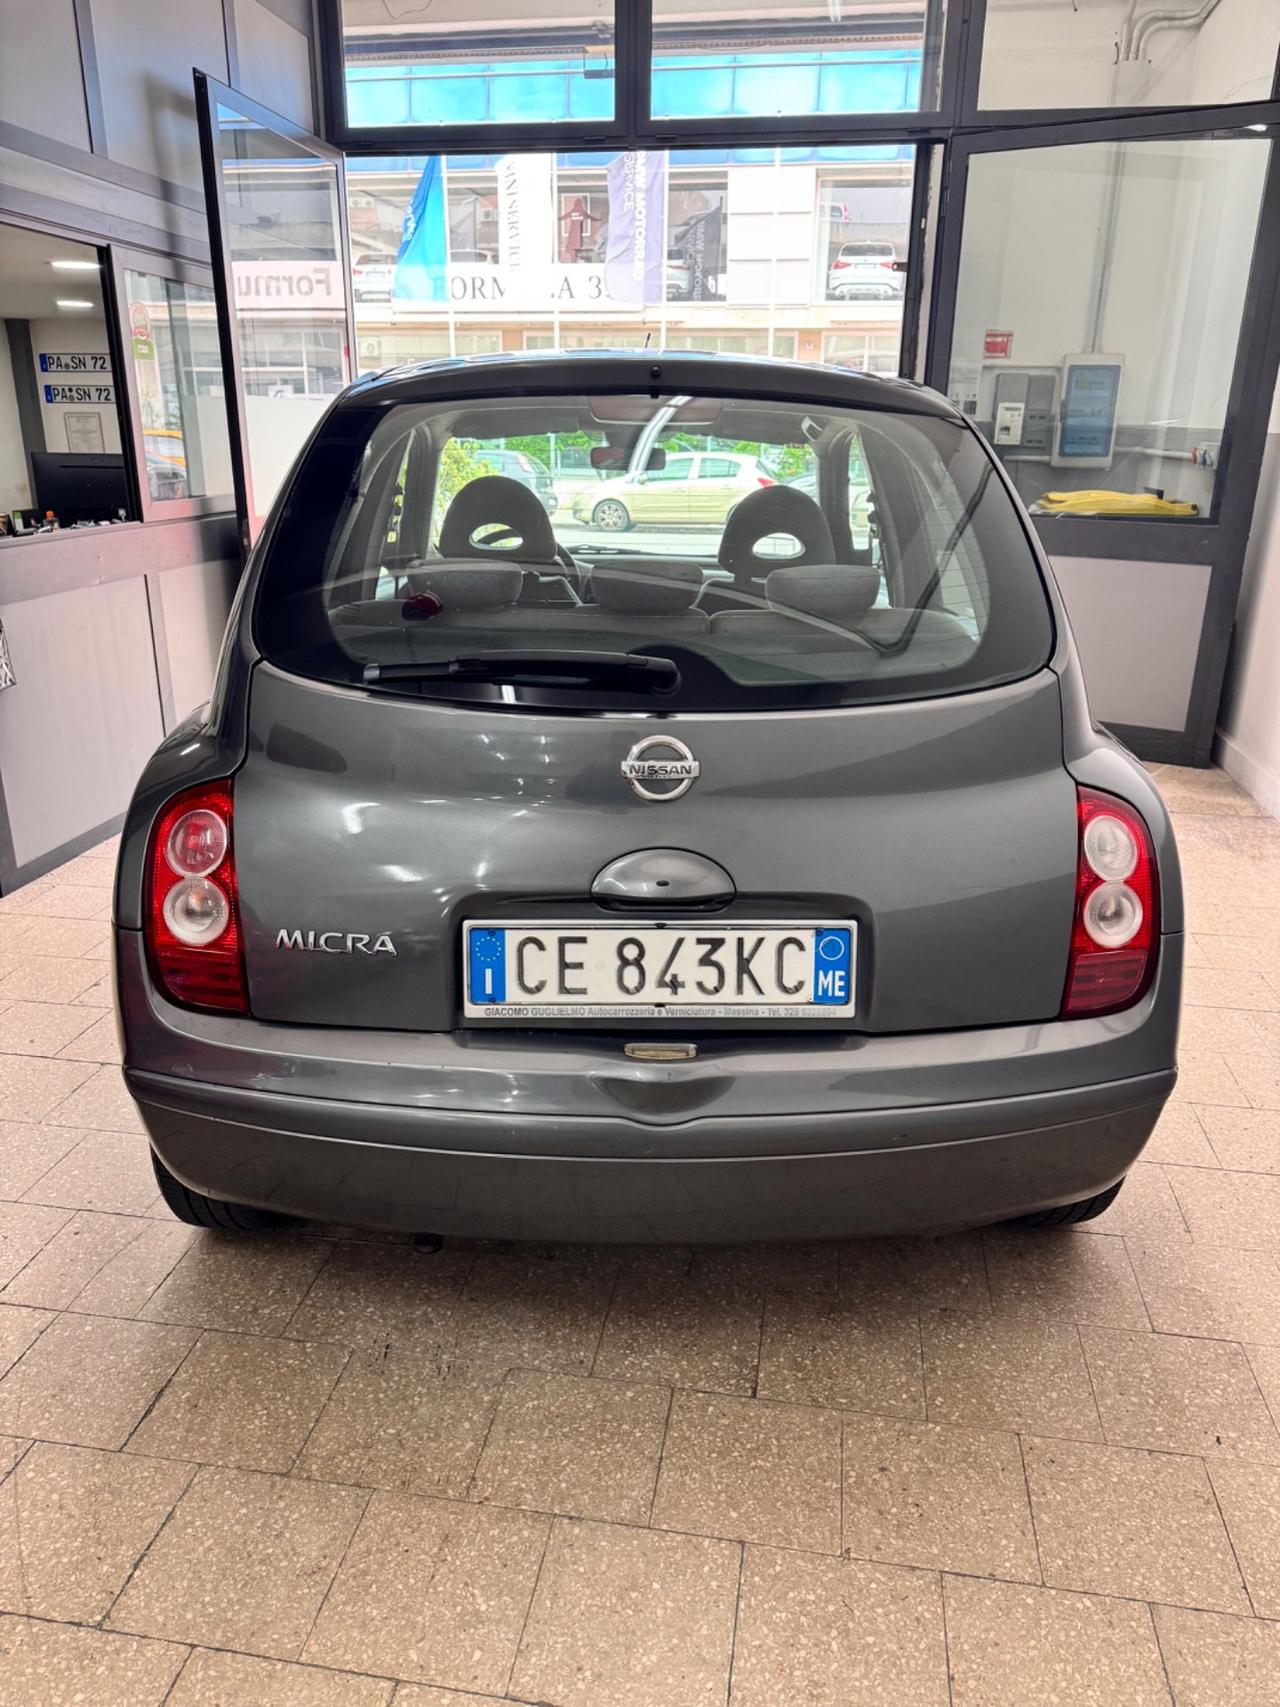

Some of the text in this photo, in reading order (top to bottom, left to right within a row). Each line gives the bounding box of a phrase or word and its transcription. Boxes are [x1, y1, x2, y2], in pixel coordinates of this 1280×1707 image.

[624, 152, 635, 212] SERVICE
[48, 355, 107, 370] PA SN 72
[52, 387, 112, 401] PA SN 72
[629, 764, 692, 775] NISSAN
[275, 928, 397, 956] MICRA
[516, 936, 806, 995] CE 843KC
[485, 968, 493, 995] I
[818, 970, 846, 997] ME
[484, 1007, 529, 1017] GIACOMO
[531, 1007, 586, 1017] GUGLIELMO
[588, 1007, 655, 1017] Autocarrozzeria
[665, 1006, 716, 1017] Verniciatura
[724, 1006, 759, 1017] Messina
